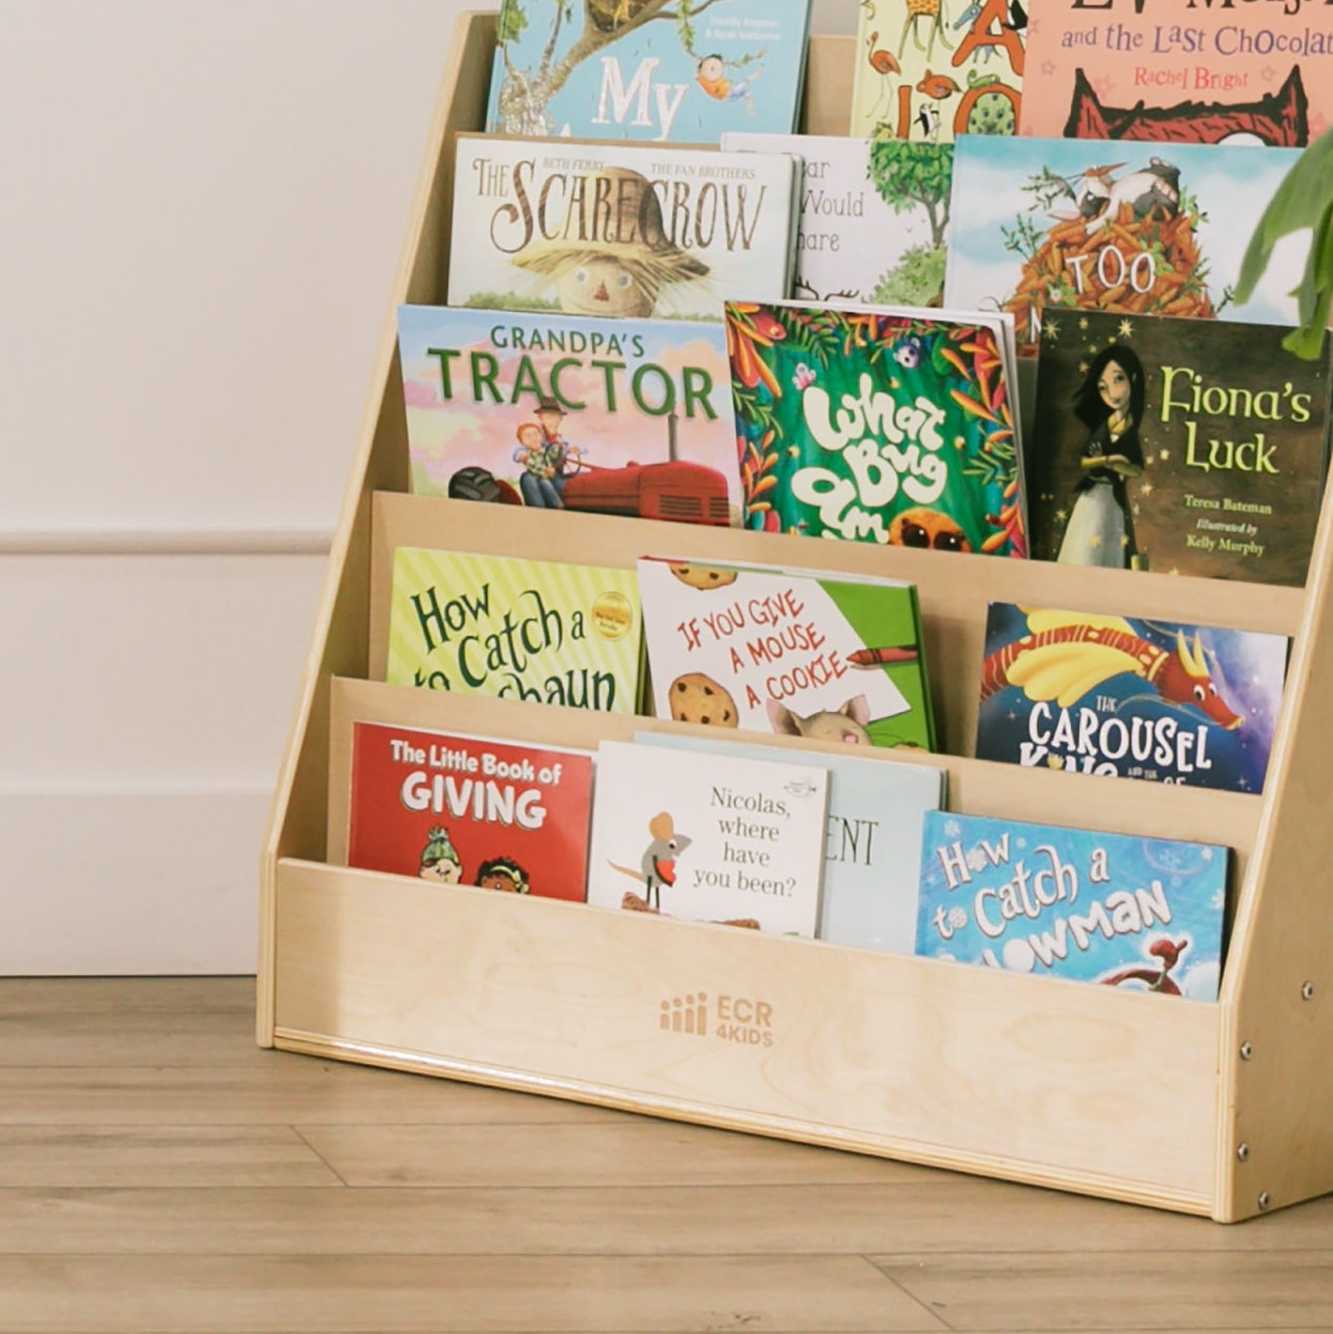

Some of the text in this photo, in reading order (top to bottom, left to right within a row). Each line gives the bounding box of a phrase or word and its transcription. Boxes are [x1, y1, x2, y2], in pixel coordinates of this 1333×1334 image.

[1062, 27, 1097, 47] and
[1106, 24, 1143, 51] the
[591, 57, 689, 142] My
[1134, 67, 1248, 90] Rachel Bright
[651, 163, 672, 174] THE
[698, 165, 756, 179] BROTHERS
[472, 158, 767, 253] THE SCARECROW
[1066, 245, 1156, 294] TOO
[490, 325, 645, 358] GRANDPA'S
[427, 347, 718, 419] TRACTOR
[1161, 366, 1312, 423] Fiona's
[803, 373, 946, 451] What
[842, 438, 948, 507] Bug
[1185, 421, 1279, 474] Luck
[1184, 494, 1272, 515] Teresa Bateman
[1196, 518, 1258, 537] Illustrated by
[1186, 534, 1265, 557] Kelly Murphy
[410, 583, 490, 655] How
[458, 590, 562, 687] Catch
[571, 611, 586, 640] a
[677, 589, 804, 652] IF YOU GIVE
[729, 622, 825, 674] A MOUSE
[745, 651, 848, 710] A COOKIE
[1095, 695, 1118, 714] THE
[390, 739, 562, 785] The Little Book of
[1028, 701, 1212, 773] CAROUSEL
[401, 771, 547, 830] GIVING
[710, 786, 791, 818] Nicolas,
[718, 818, 780, 842] where
[723, 842, 770, 867] have
[693, 868, 796, 898] you been?
[937, 833, 1010, 891] How
[934, 844, 1110, 939] to Catch a
[716, 994, 773, 1027] ECR
[716, 1024, 773, 1048] 4KIDS
